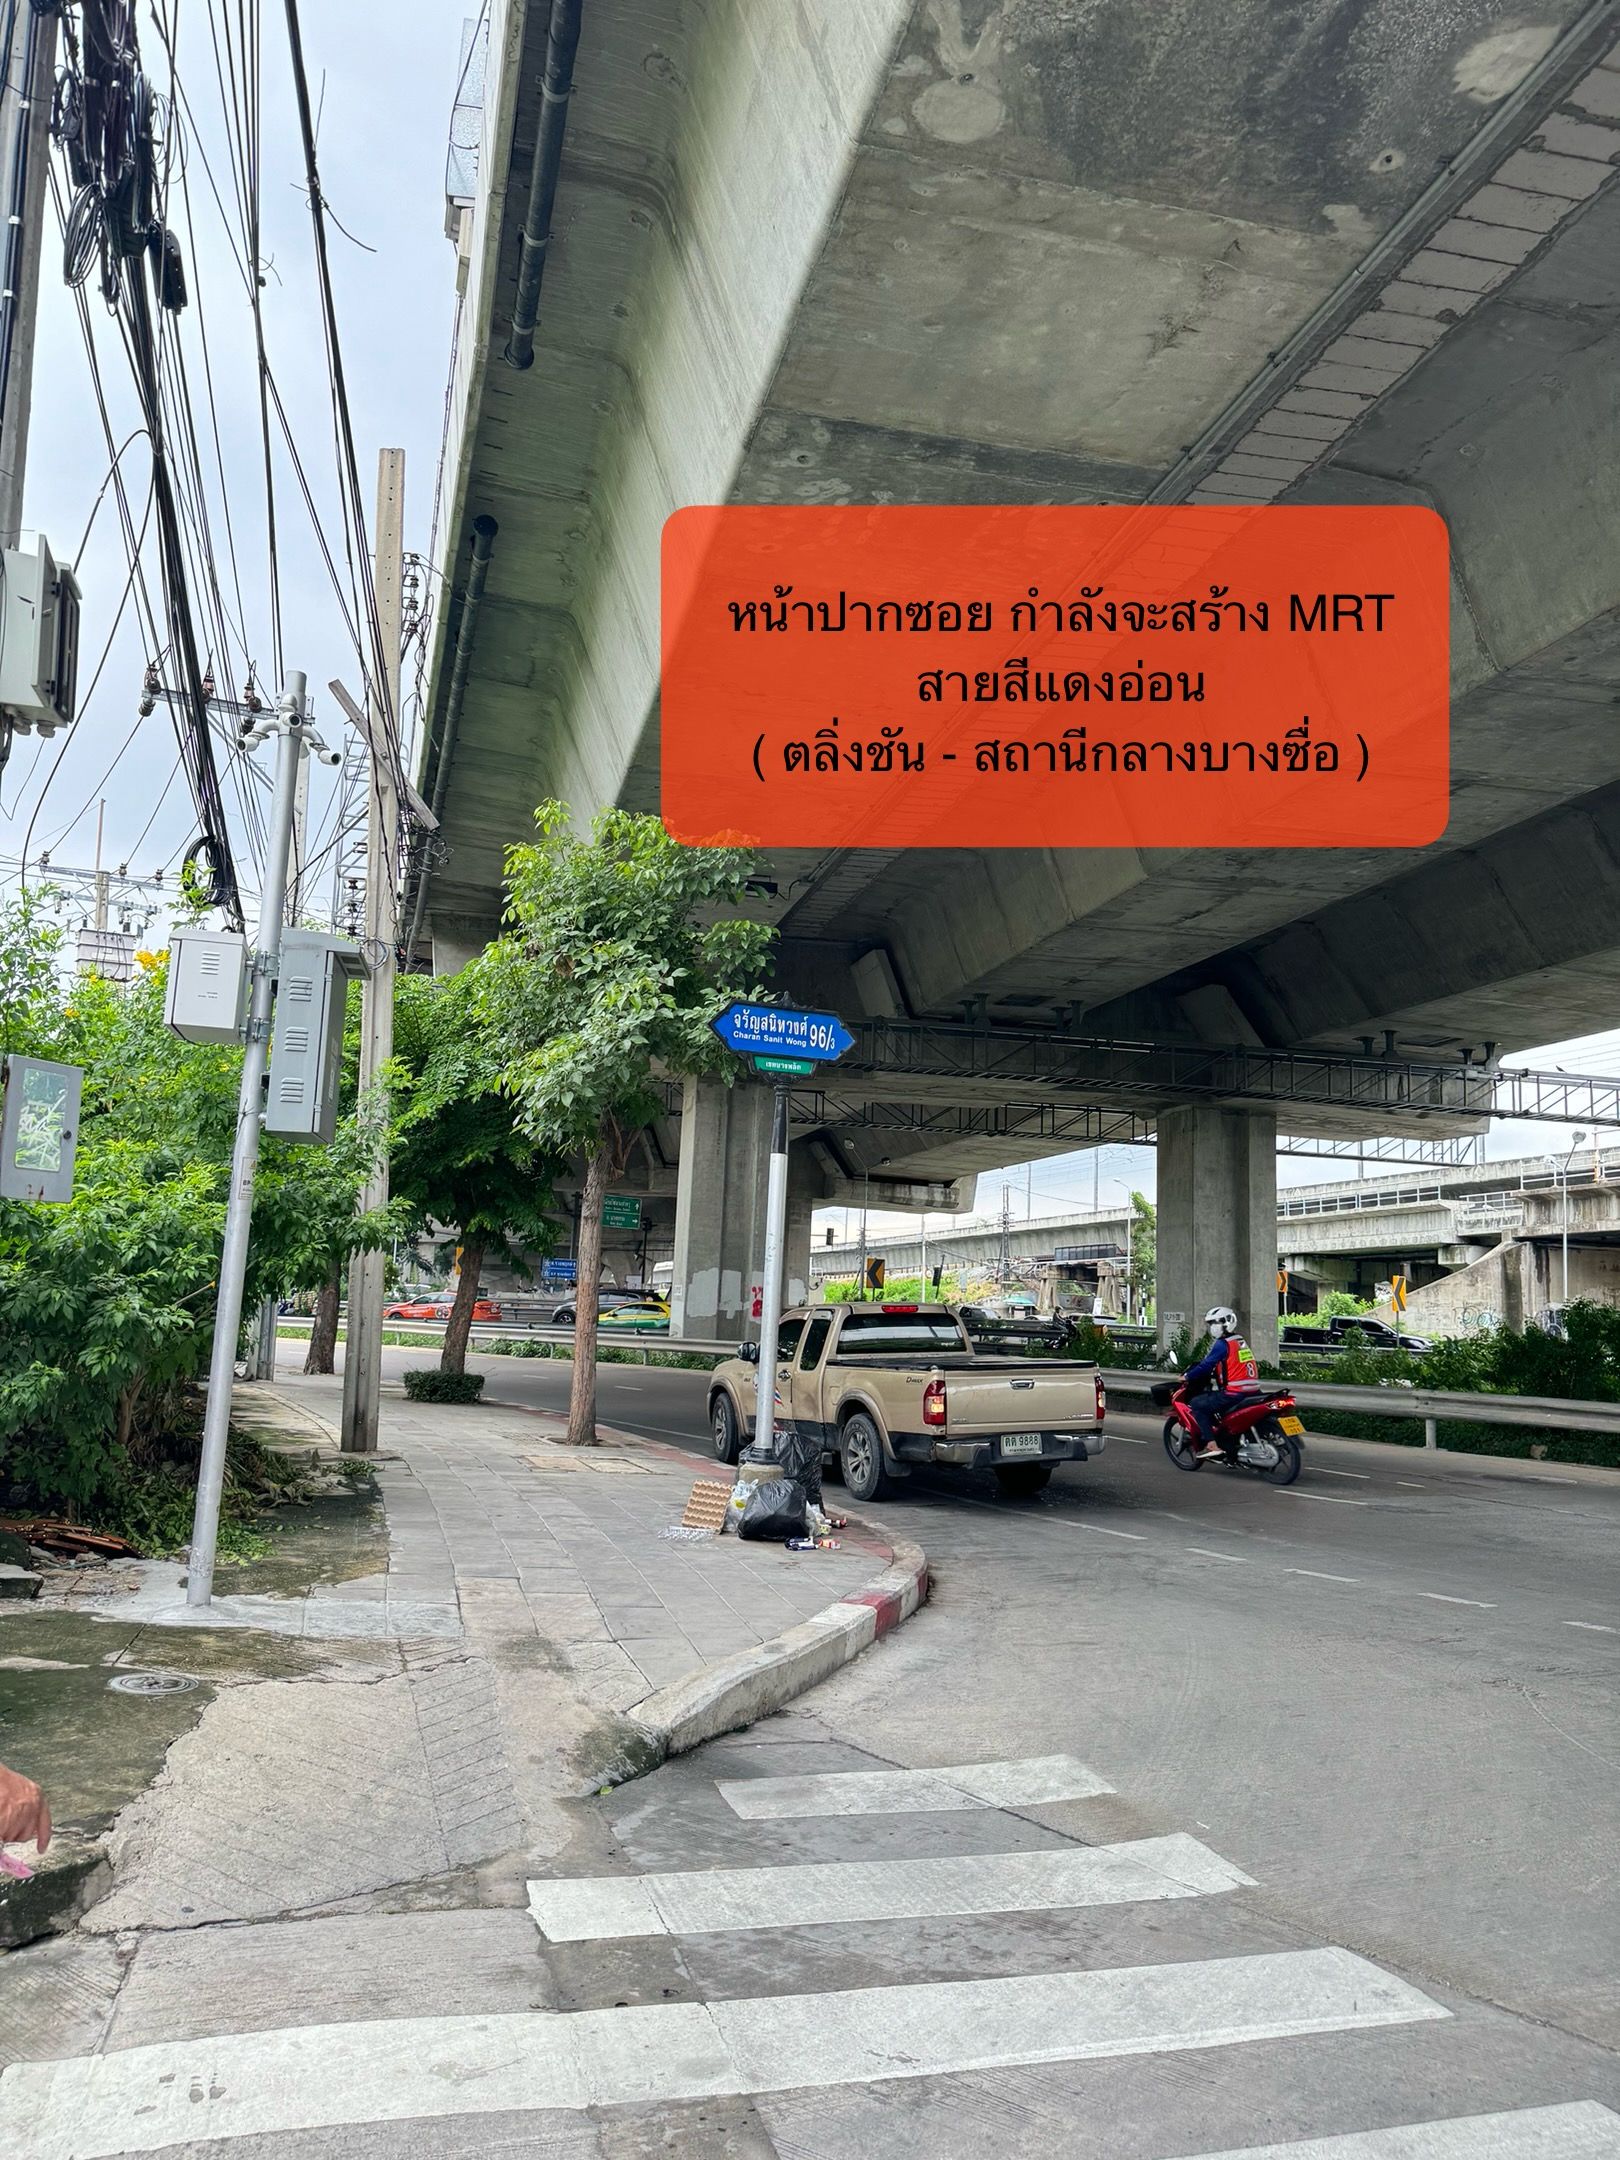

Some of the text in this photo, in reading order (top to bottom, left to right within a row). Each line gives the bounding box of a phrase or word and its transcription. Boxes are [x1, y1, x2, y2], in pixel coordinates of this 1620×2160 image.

[733, 1009, 835, 1051] จรัญสนิทวงศ์ 96/3
[733, 1030, 807, 1048] Charan Sanit Wong
